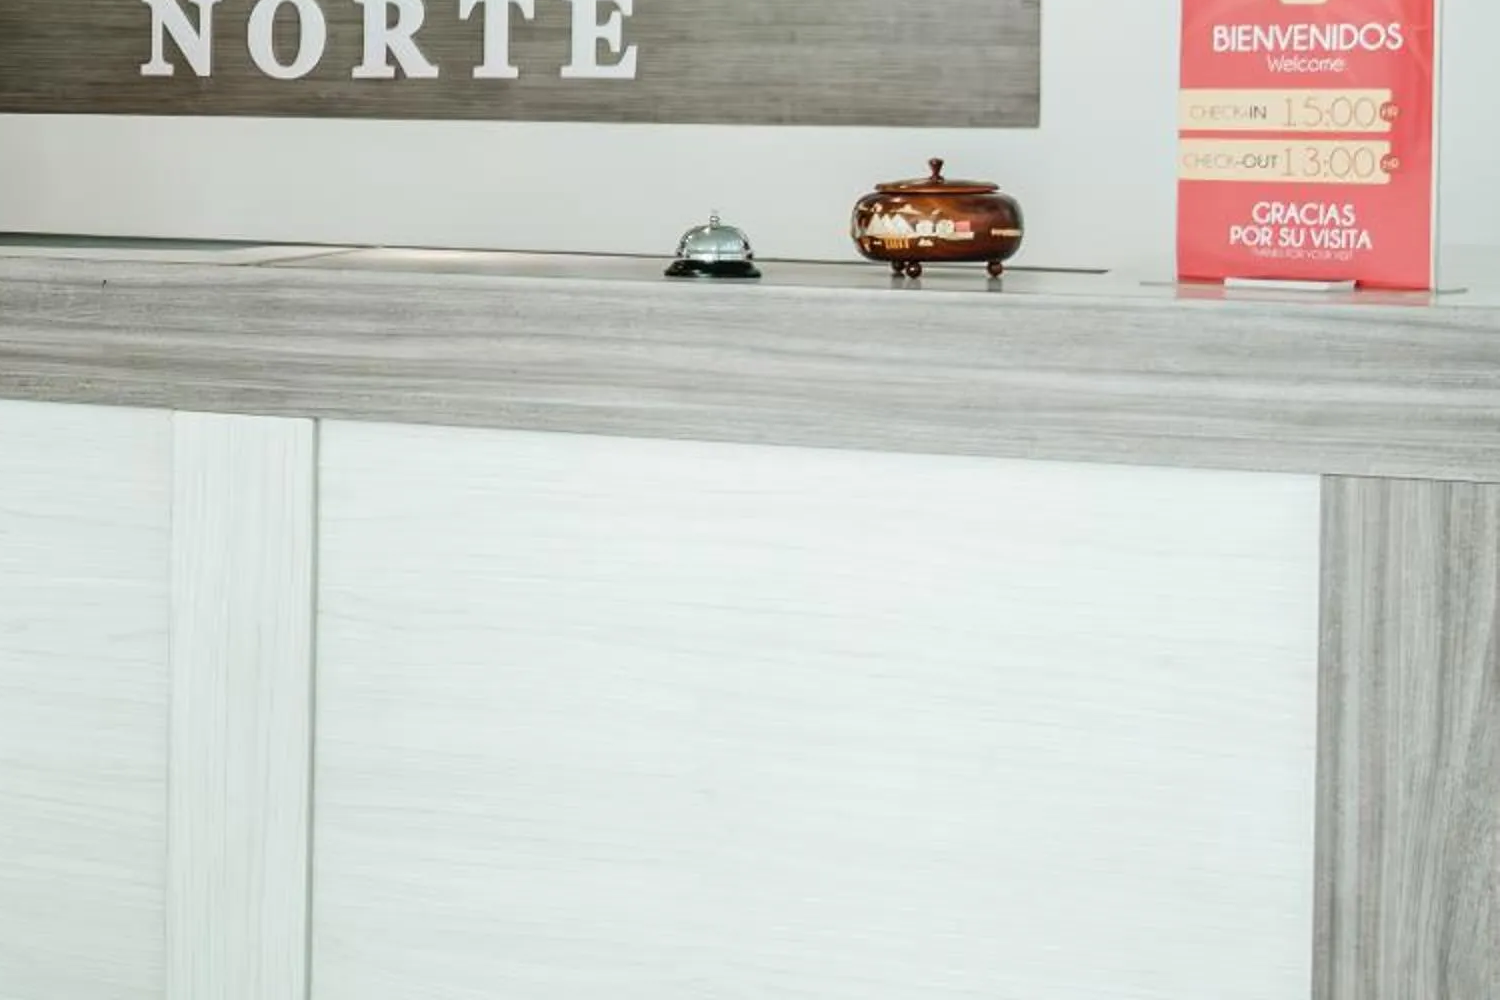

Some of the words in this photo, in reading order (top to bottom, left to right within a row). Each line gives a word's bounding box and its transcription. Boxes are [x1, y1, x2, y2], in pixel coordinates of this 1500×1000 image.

[1213, 22, 1404, 52] BIENVENIDOS
[1267, 54, 1346, 73] Welcome
[1283, 96, 1377, 128] 15:00
[1281, 146, 1375, 178] 13:00
[1252, 200, 1356, 227] GRACIAS
[1229, 225, 1272, 246] POR
[1278, 227, 1305, 247] SU
[1310, 228, 1373, 250] VISITA
